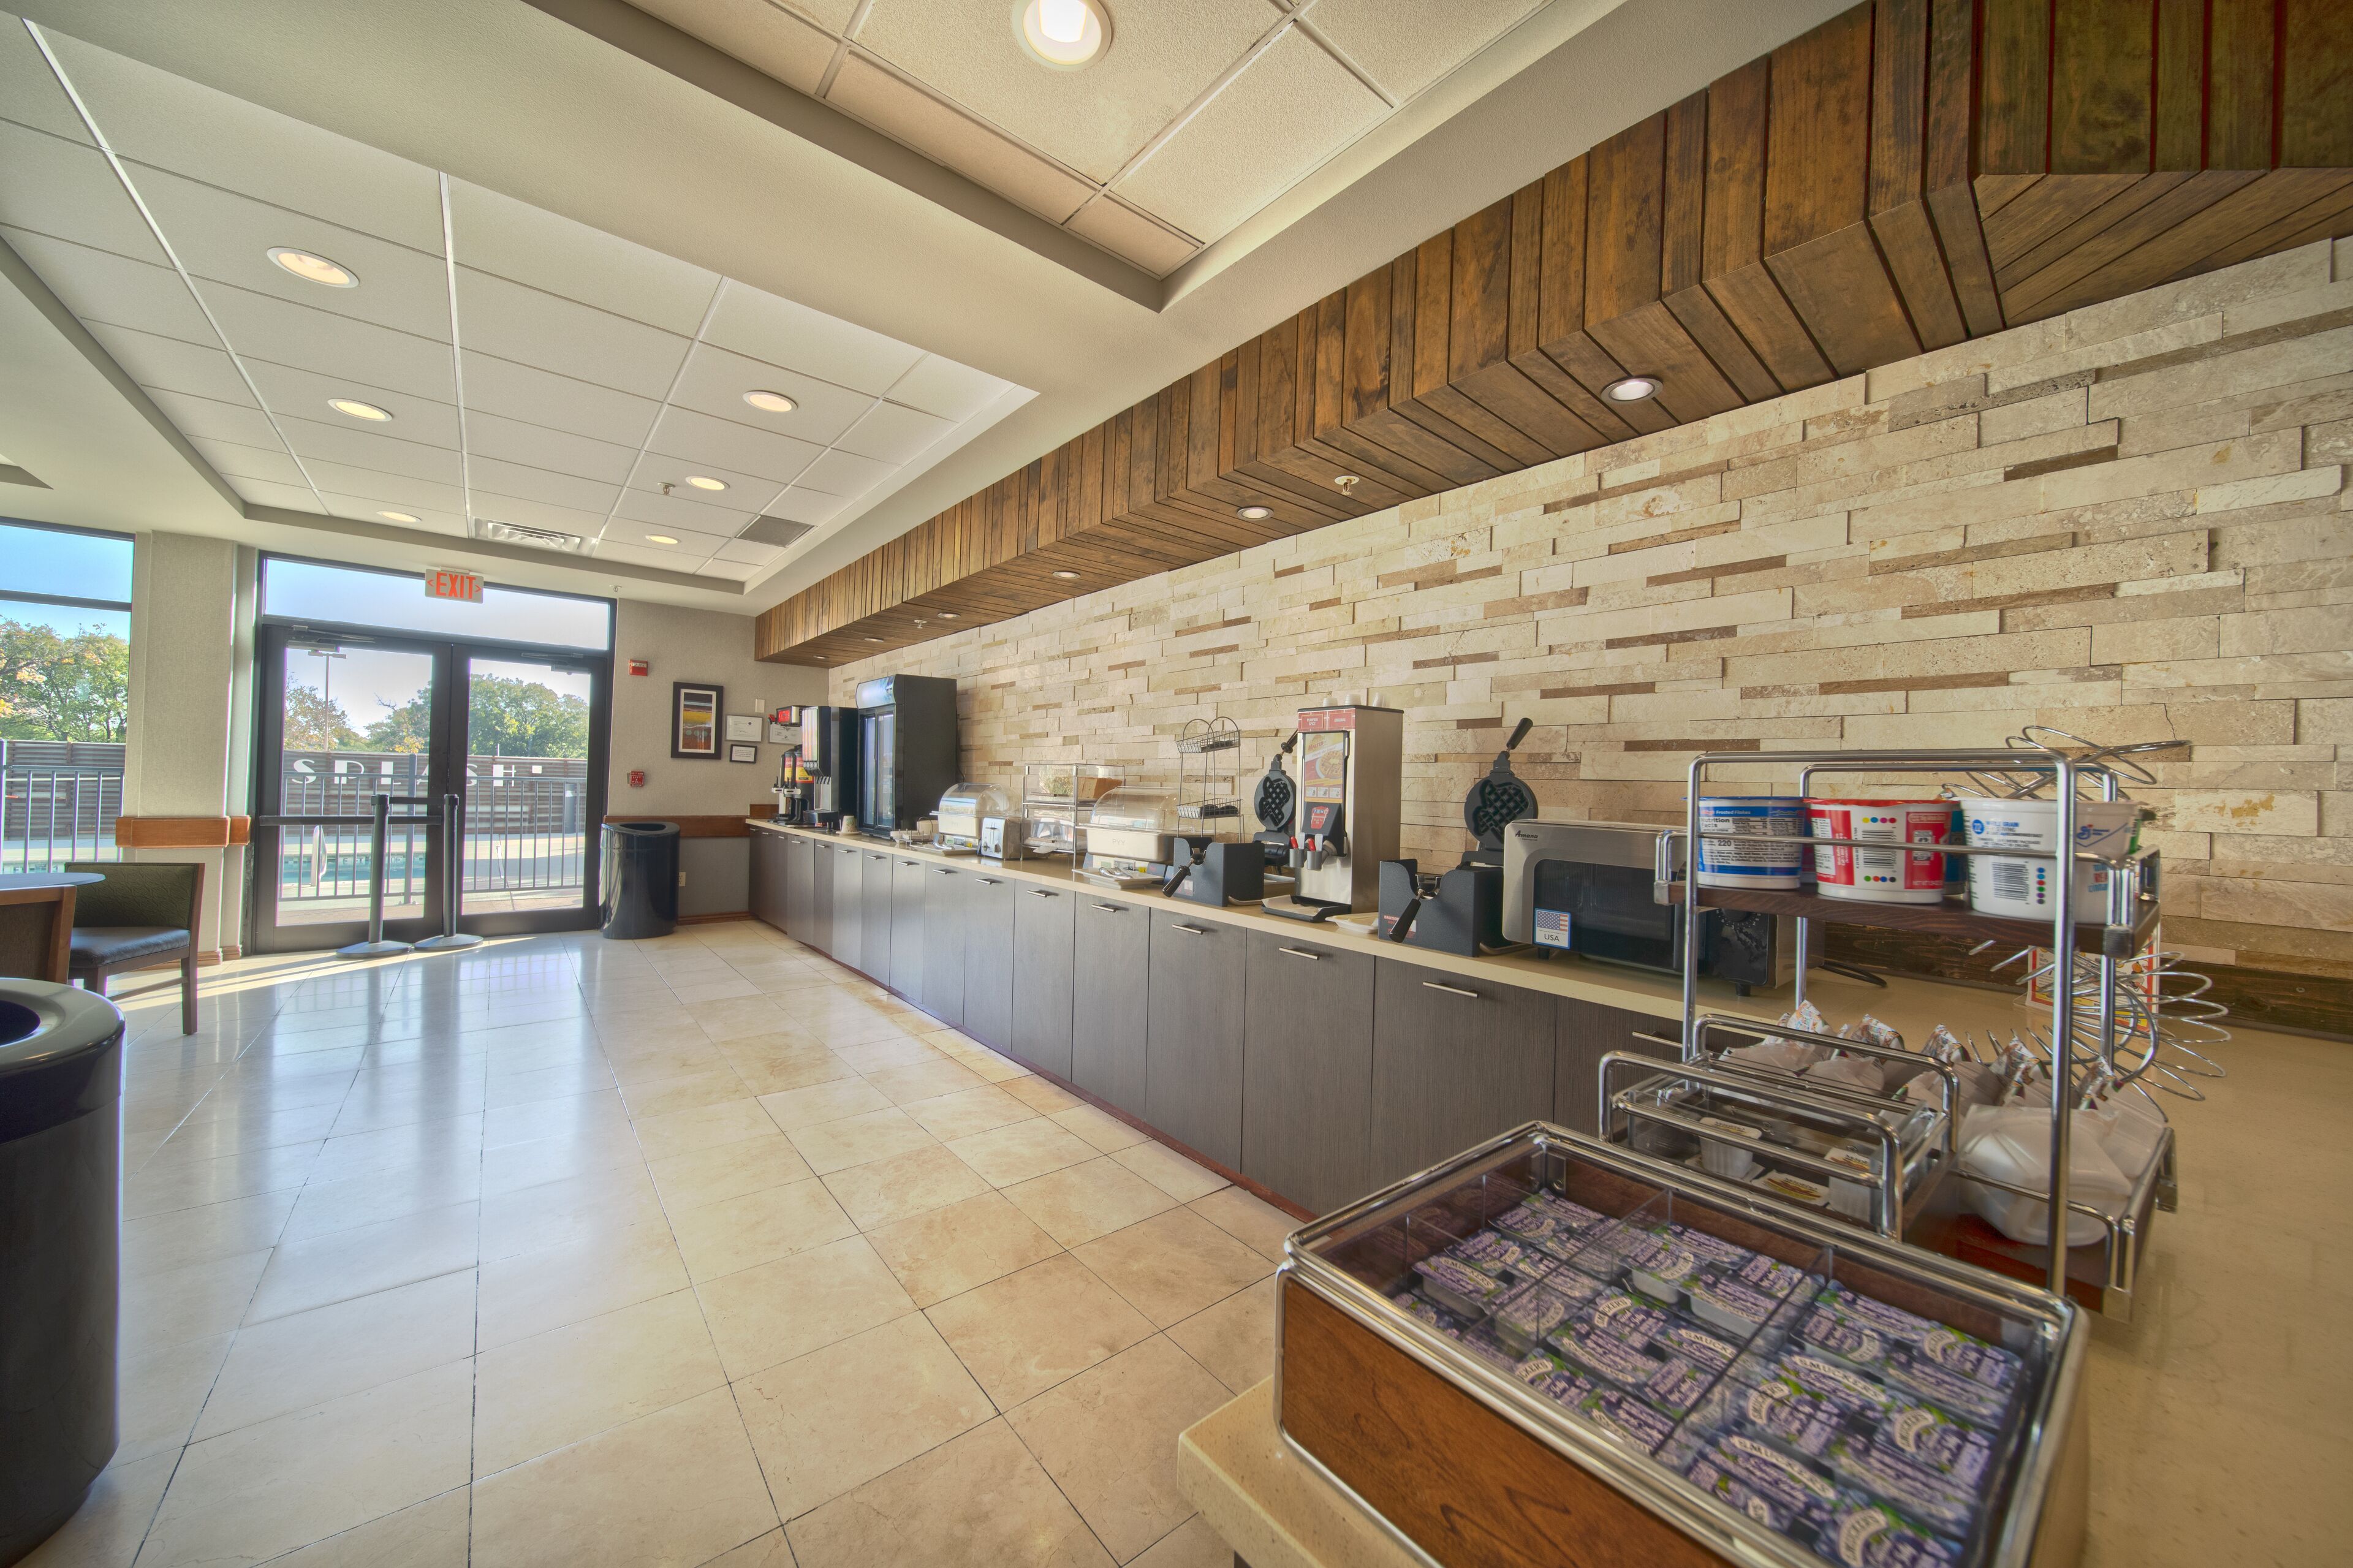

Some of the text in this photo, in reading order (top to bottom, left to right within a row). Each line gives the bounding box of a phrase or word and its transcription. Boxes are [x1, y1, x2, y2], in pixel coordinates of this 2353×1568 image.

[436, 572, 476, 599] EXIT
[1515, 830, 1539, 839] Amana
[1544, 933, 1559, 942] USA
[1595, 1298, 1629, 1327] SMCKER'S
[1684, 1331, 1737, 1358] SMUCK
[1750, 1384, 1785, 1422] SMUCER'S
